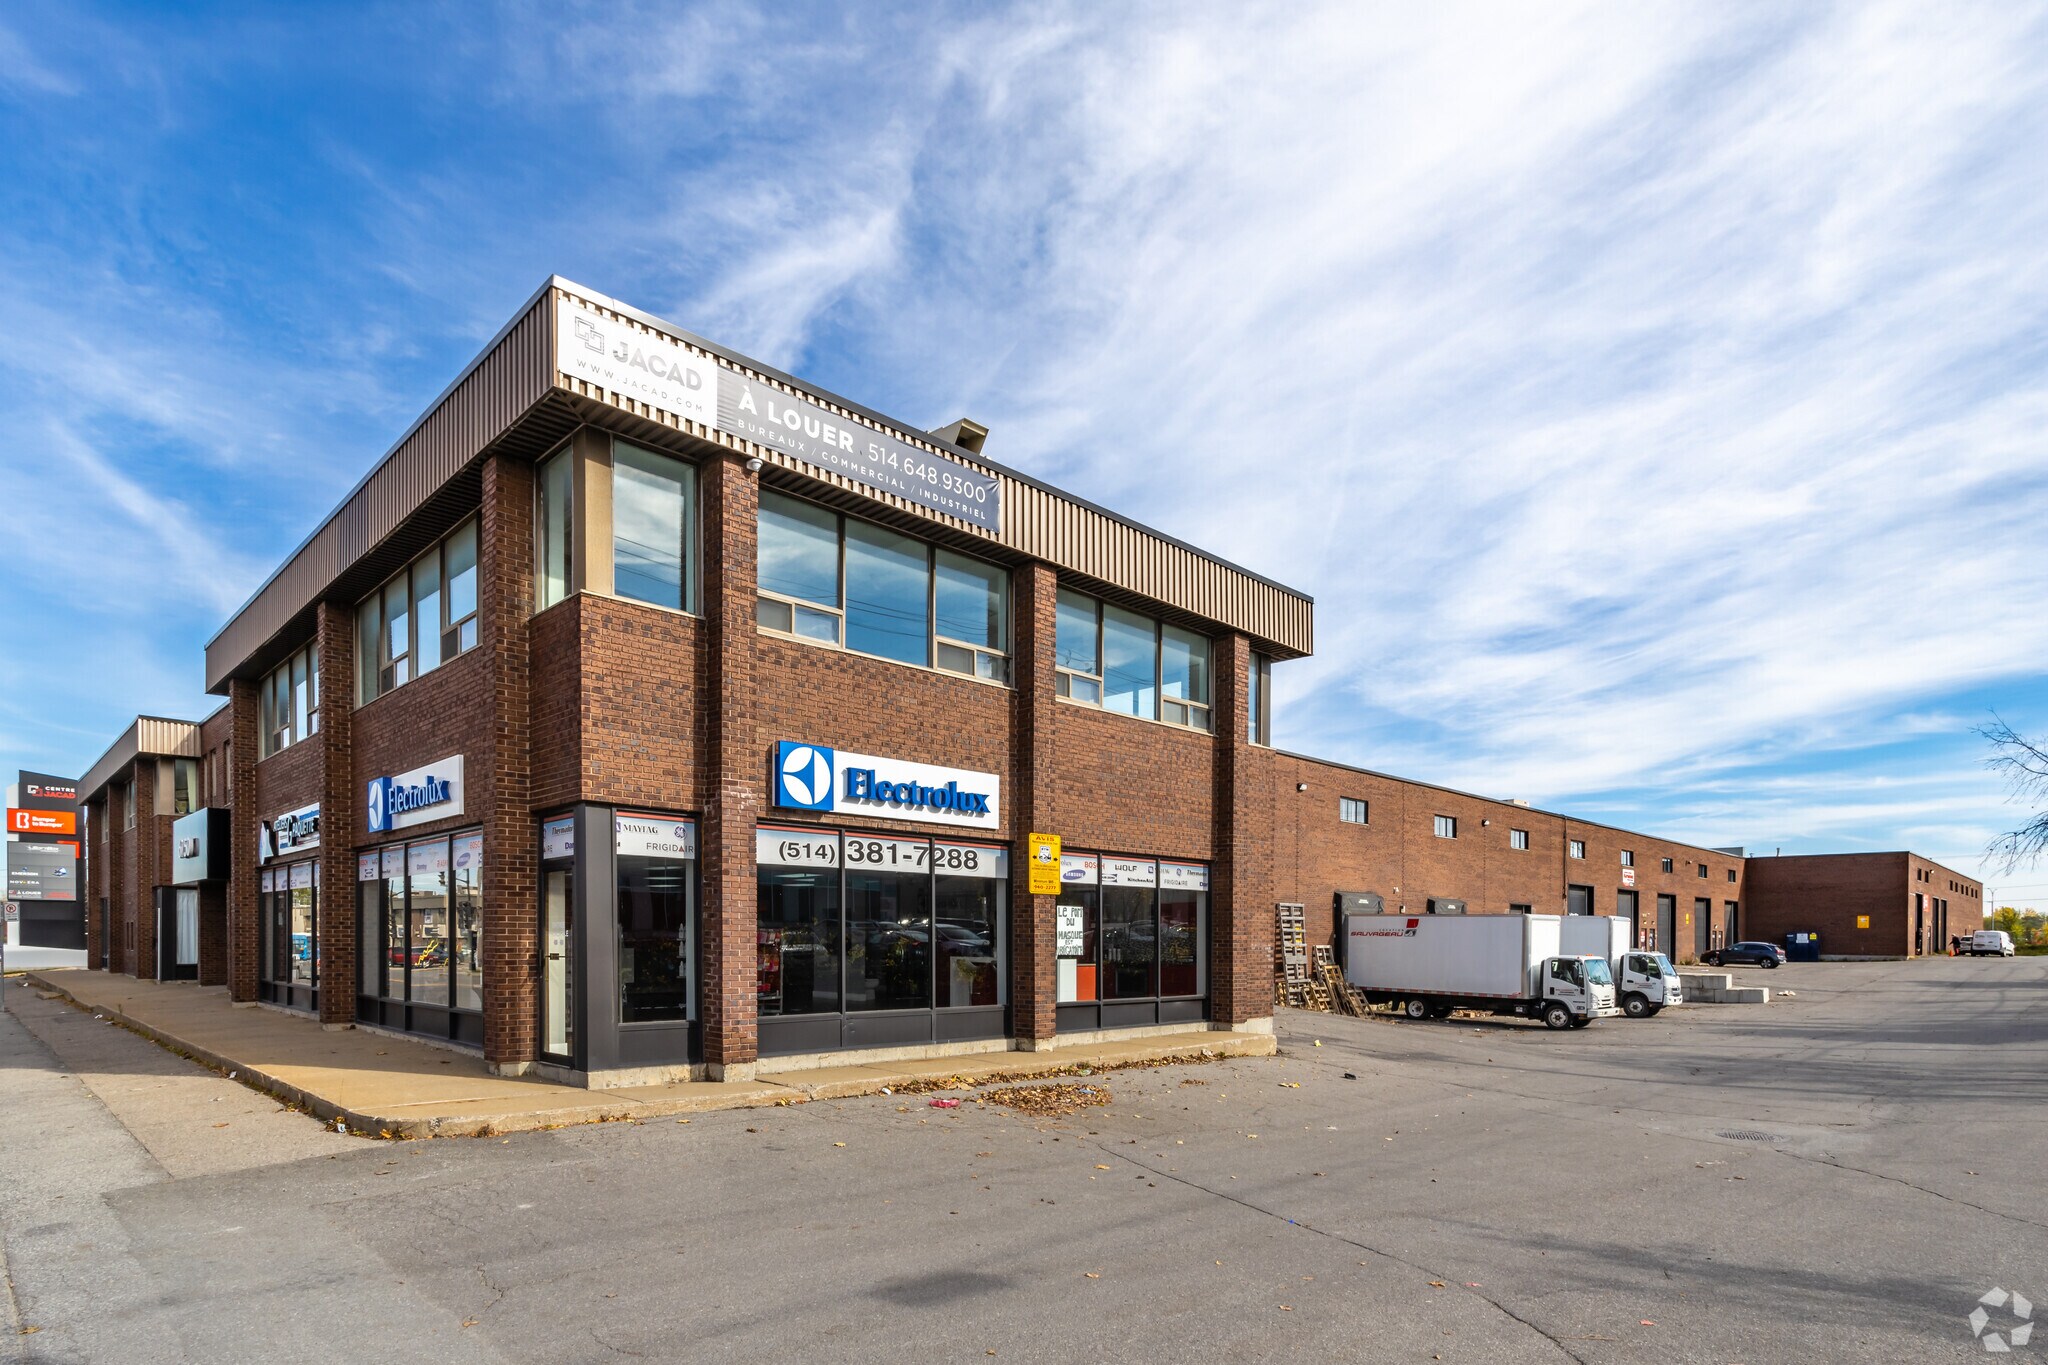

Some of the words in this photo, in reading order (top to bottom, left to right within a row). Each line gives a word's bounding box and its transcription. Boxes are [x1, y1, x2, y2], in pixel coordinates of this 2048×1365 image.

[576, 358, 703, 413] WWW.JACAD.COM
[612, 341, 703, 392] JACAD
[738, 385, 758, 416] À
[768, 401, 854, 454] LOUER
[868, 443, 986, 503] 514.648.9300
[738, 418, 805, 452] BUREAUX
[822, 451, 906, 490] COMMERCIAL
[919, 488, 986, 520] INDUSTRIEL
[44, 791, 76, 799] JACAD
[388, 776, 449, 815] Electrolux
[846, 766, 991, 814] Electrolux
[623, 824, 659, 834] MAYTAG
[779, 841, 836, 866] (514)
[847, 840, 979, 870] 381-7288
[1084, 861, 1105, 869] BOSH
[1114, 864, 1138, 872] WOLF
